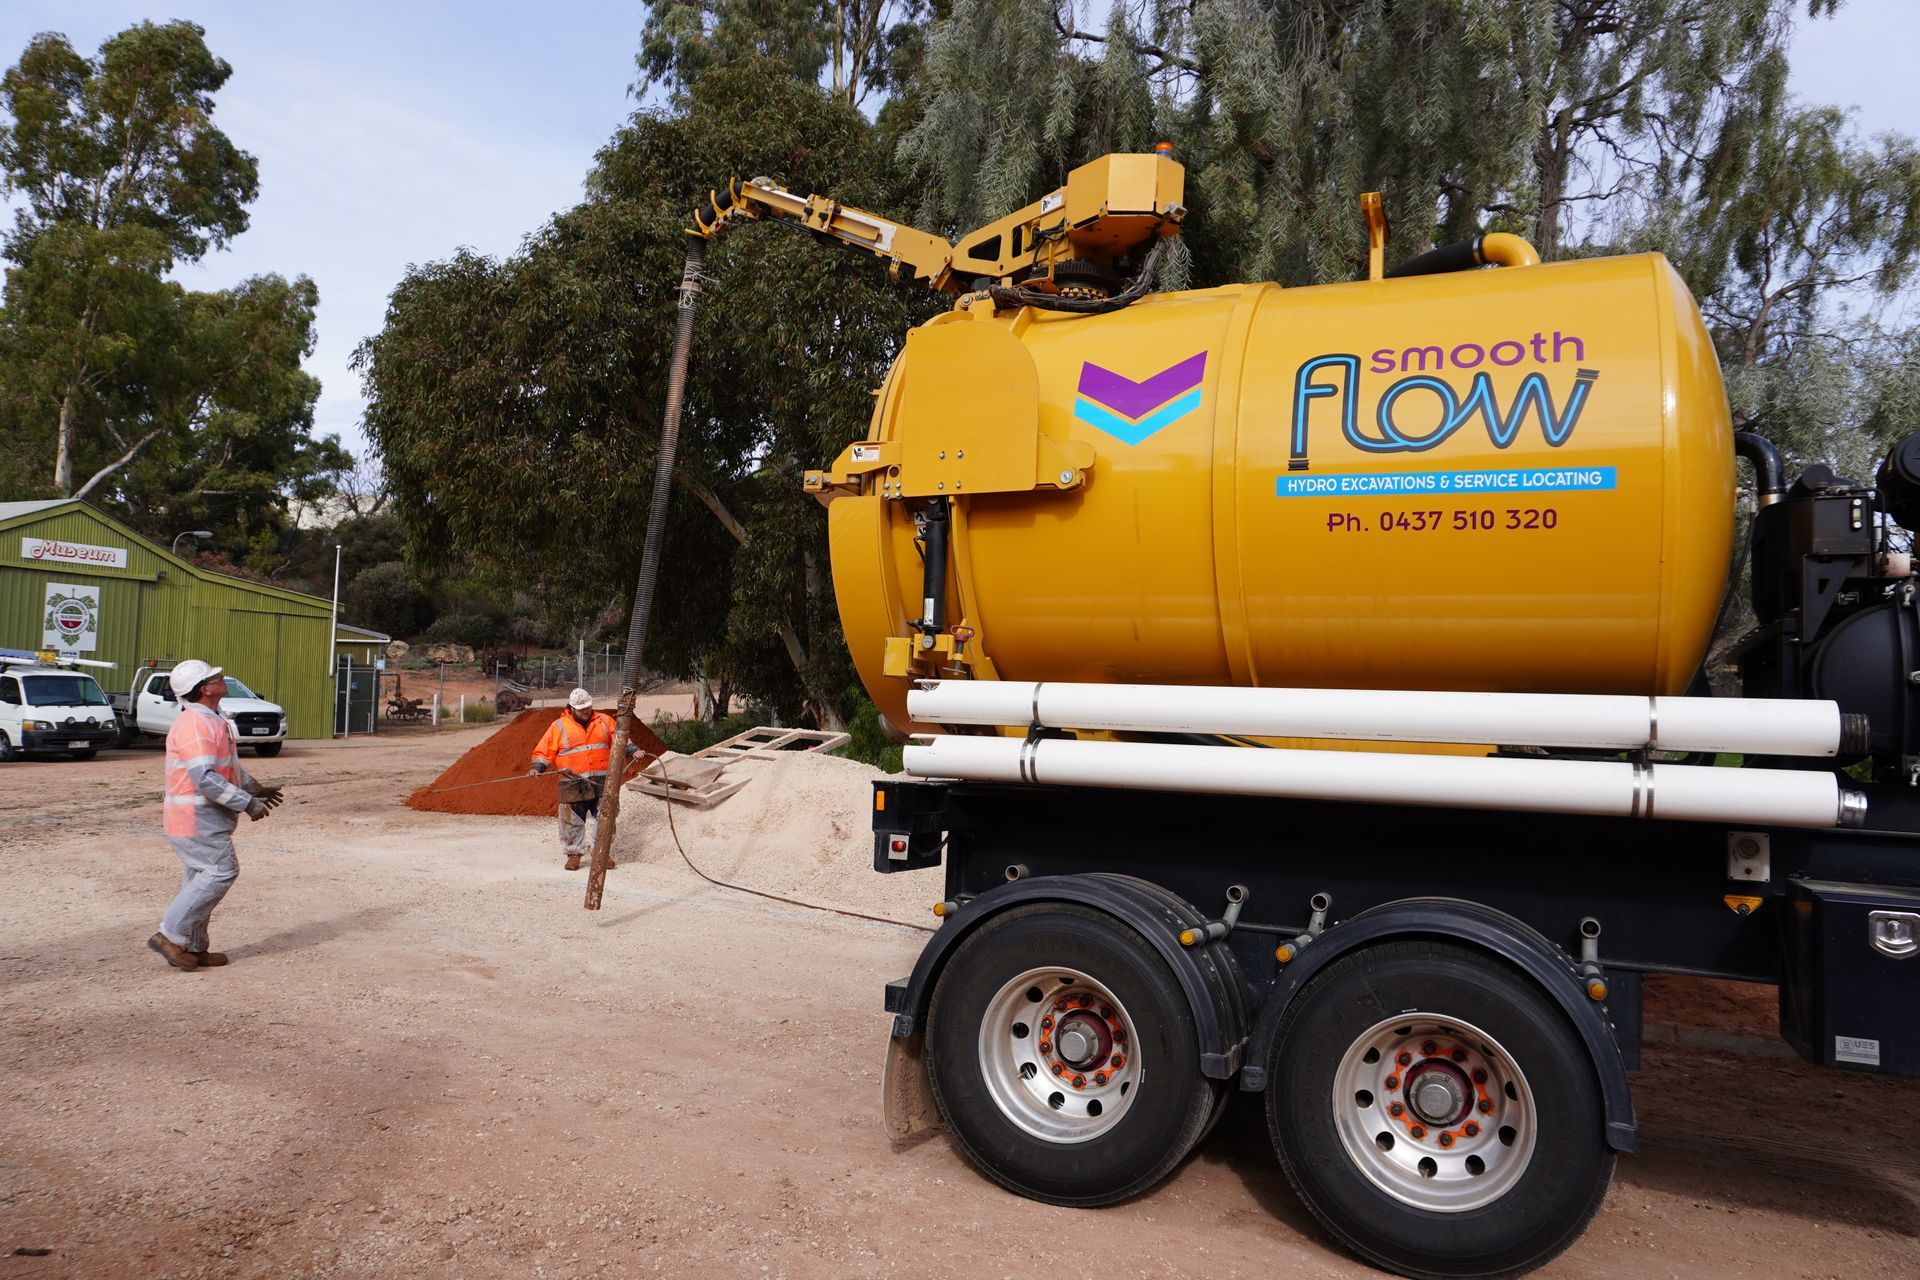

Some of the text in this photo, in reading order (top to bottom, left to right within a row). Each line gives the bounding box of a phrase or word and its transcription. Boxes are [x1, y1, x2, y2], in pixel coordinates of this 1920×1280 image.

[1370, 331, 1584, 374] smooth
[1288, 353, 1600, 471] flow
[1288, 471, 1602, 492] HYDRO EXCAVATIONS & SERVICE LOCATING
[1327, 508, 1557, 532] Ph. 0437 510 320
[31, 540, 116, 562] Museum
